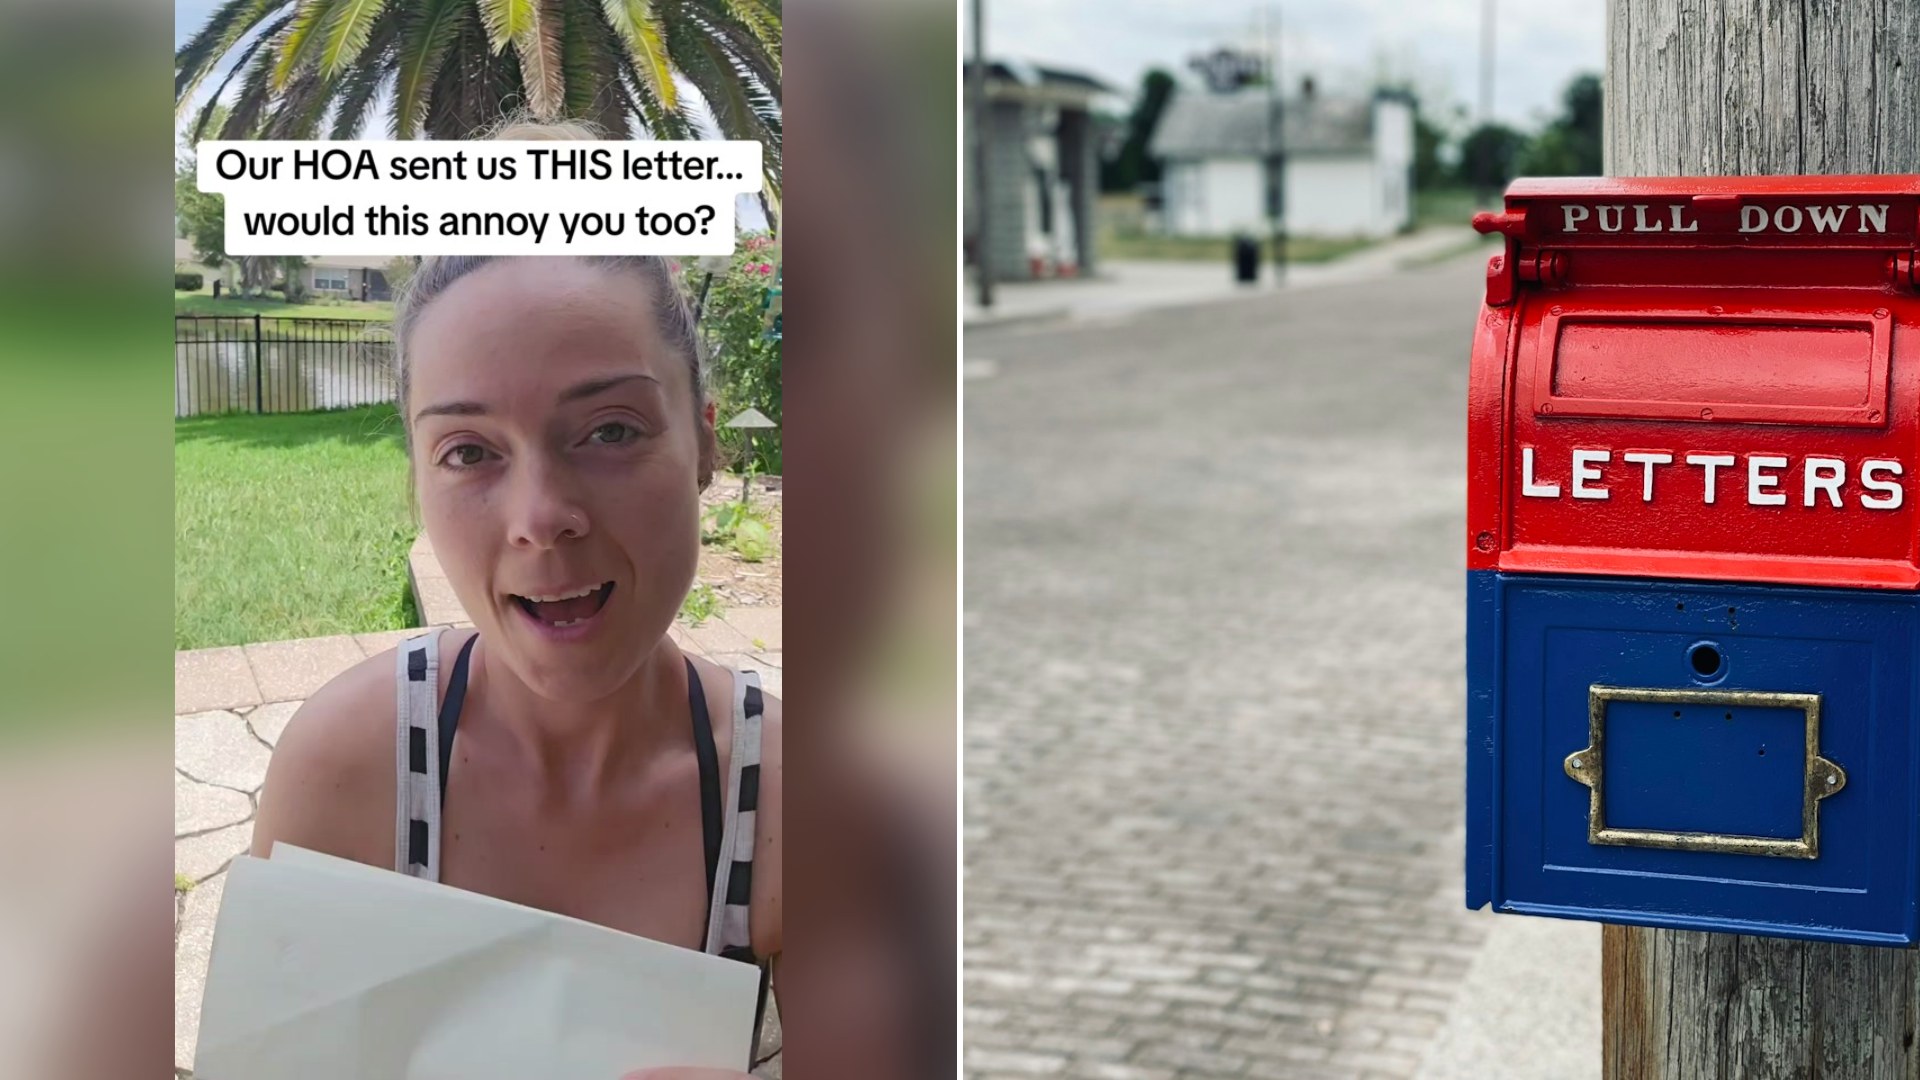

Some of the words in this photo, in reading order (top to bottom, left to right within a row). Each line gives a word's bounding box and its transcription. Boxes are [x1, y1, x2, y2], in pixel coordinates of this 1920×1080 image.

[1561, 204, 1698, 232] PULL
[1738, 204, 1890, 233] DOWN
[1522, 447, 1904, 509] LETTERS
